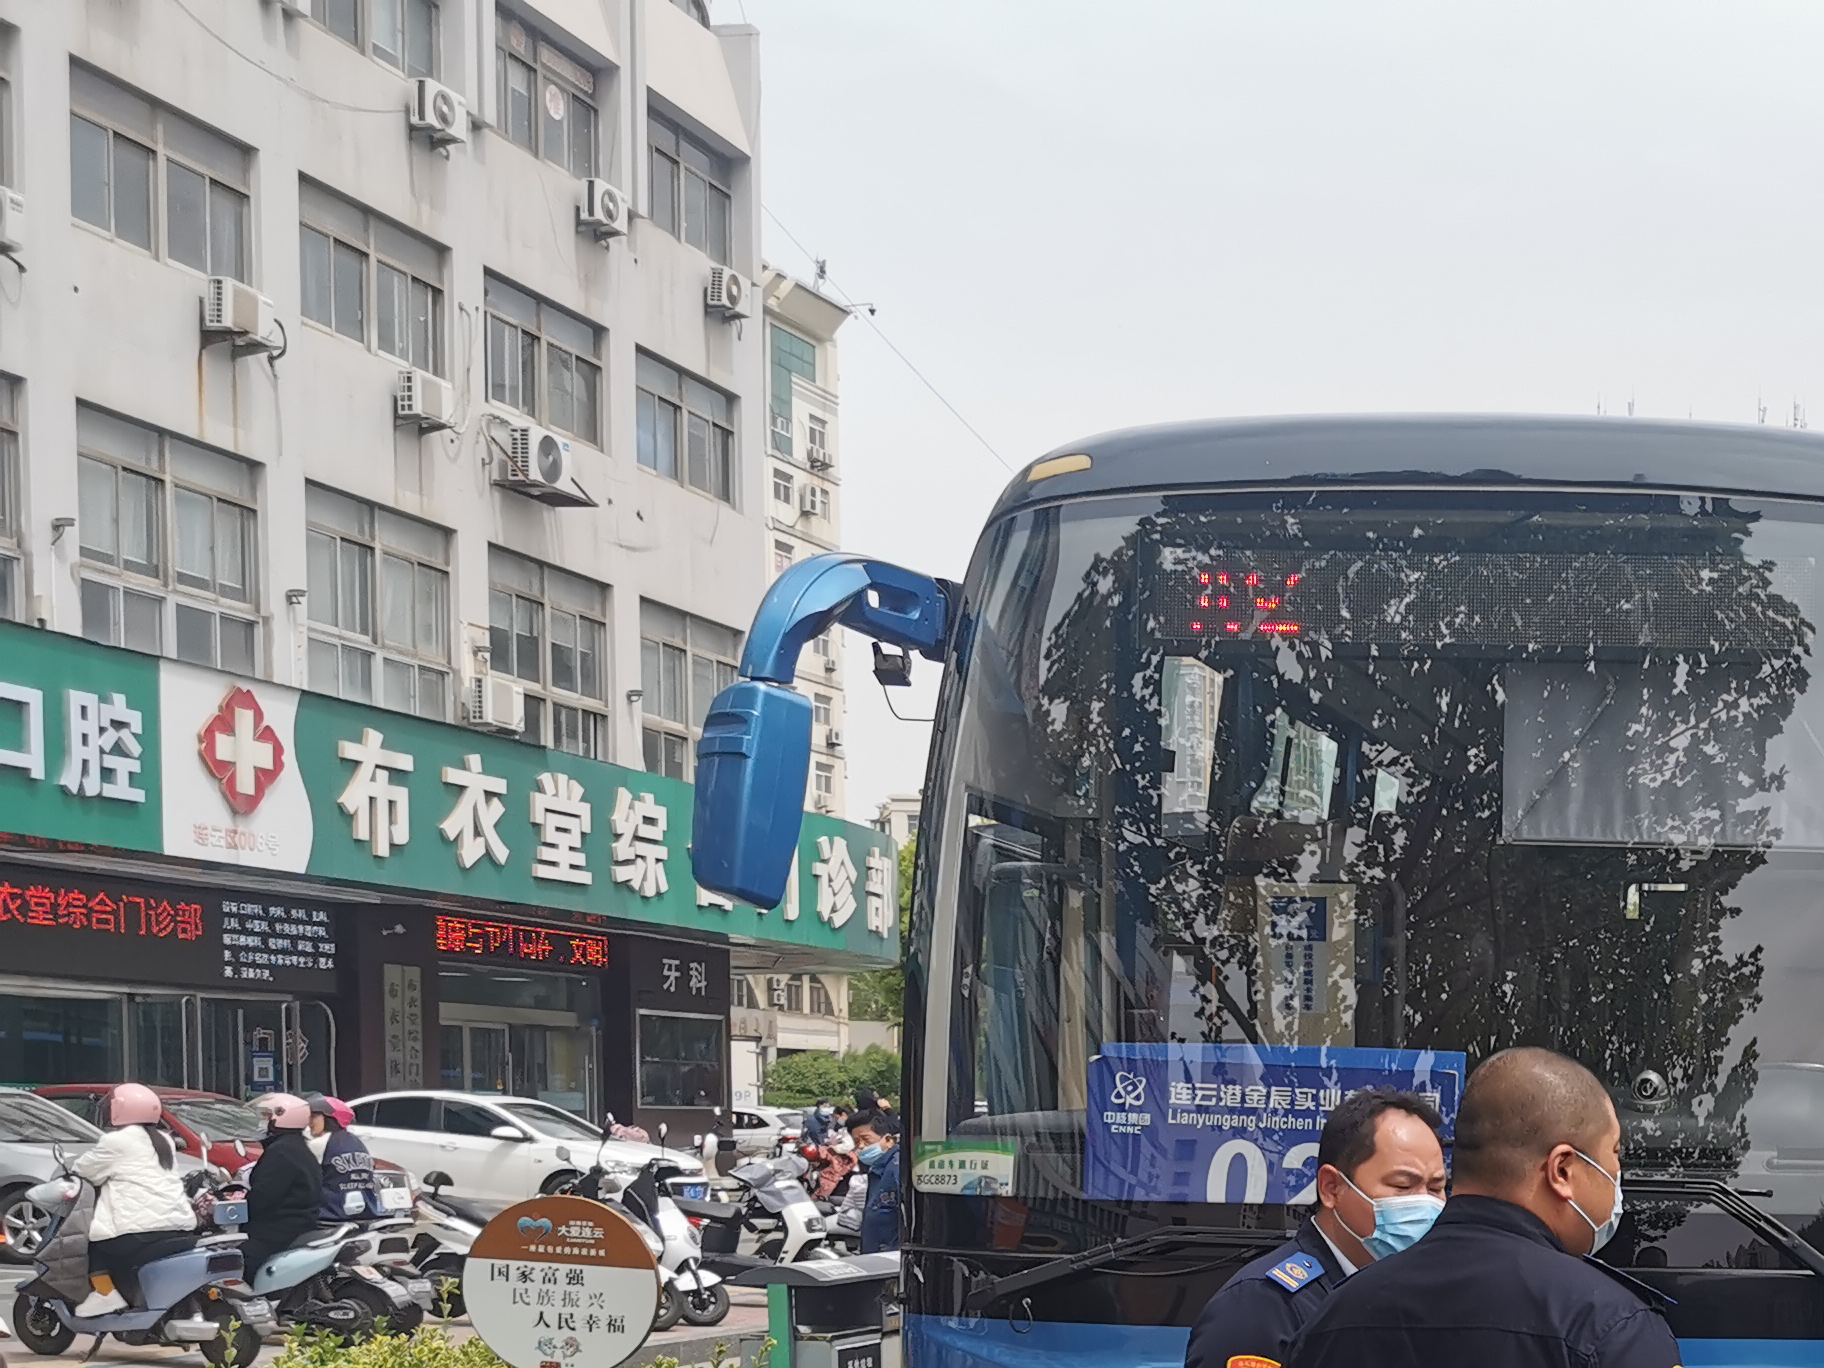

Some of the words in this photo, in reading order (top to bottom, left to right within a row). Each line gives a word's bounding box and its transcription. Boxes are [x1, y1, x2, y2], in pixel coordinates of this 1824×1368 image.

[0, 682, 145, 803] 口腔
[337, 727, 894, 939] 布衣堂综诊部
[662, 958, 707, 996] 牙科
[1168, 1081, 1440, 1113] 连云港金辰实业司
[1103, 1111, 1151, 1126] 中核集团
[1110, 1125, 1142, 1135] CNNC
[1167, 1108, 1256, 1131] Lianyungang
[1258, 1111, 1314, 1130] Jinchen
[557, 1225, 604, 1239] 大爱连云
[490, 1263, 585, 1287] 国家富强
[512, 1288, 606, 1310] 民族振兴
[532, 1311, 626, 1334] 人民幸福
